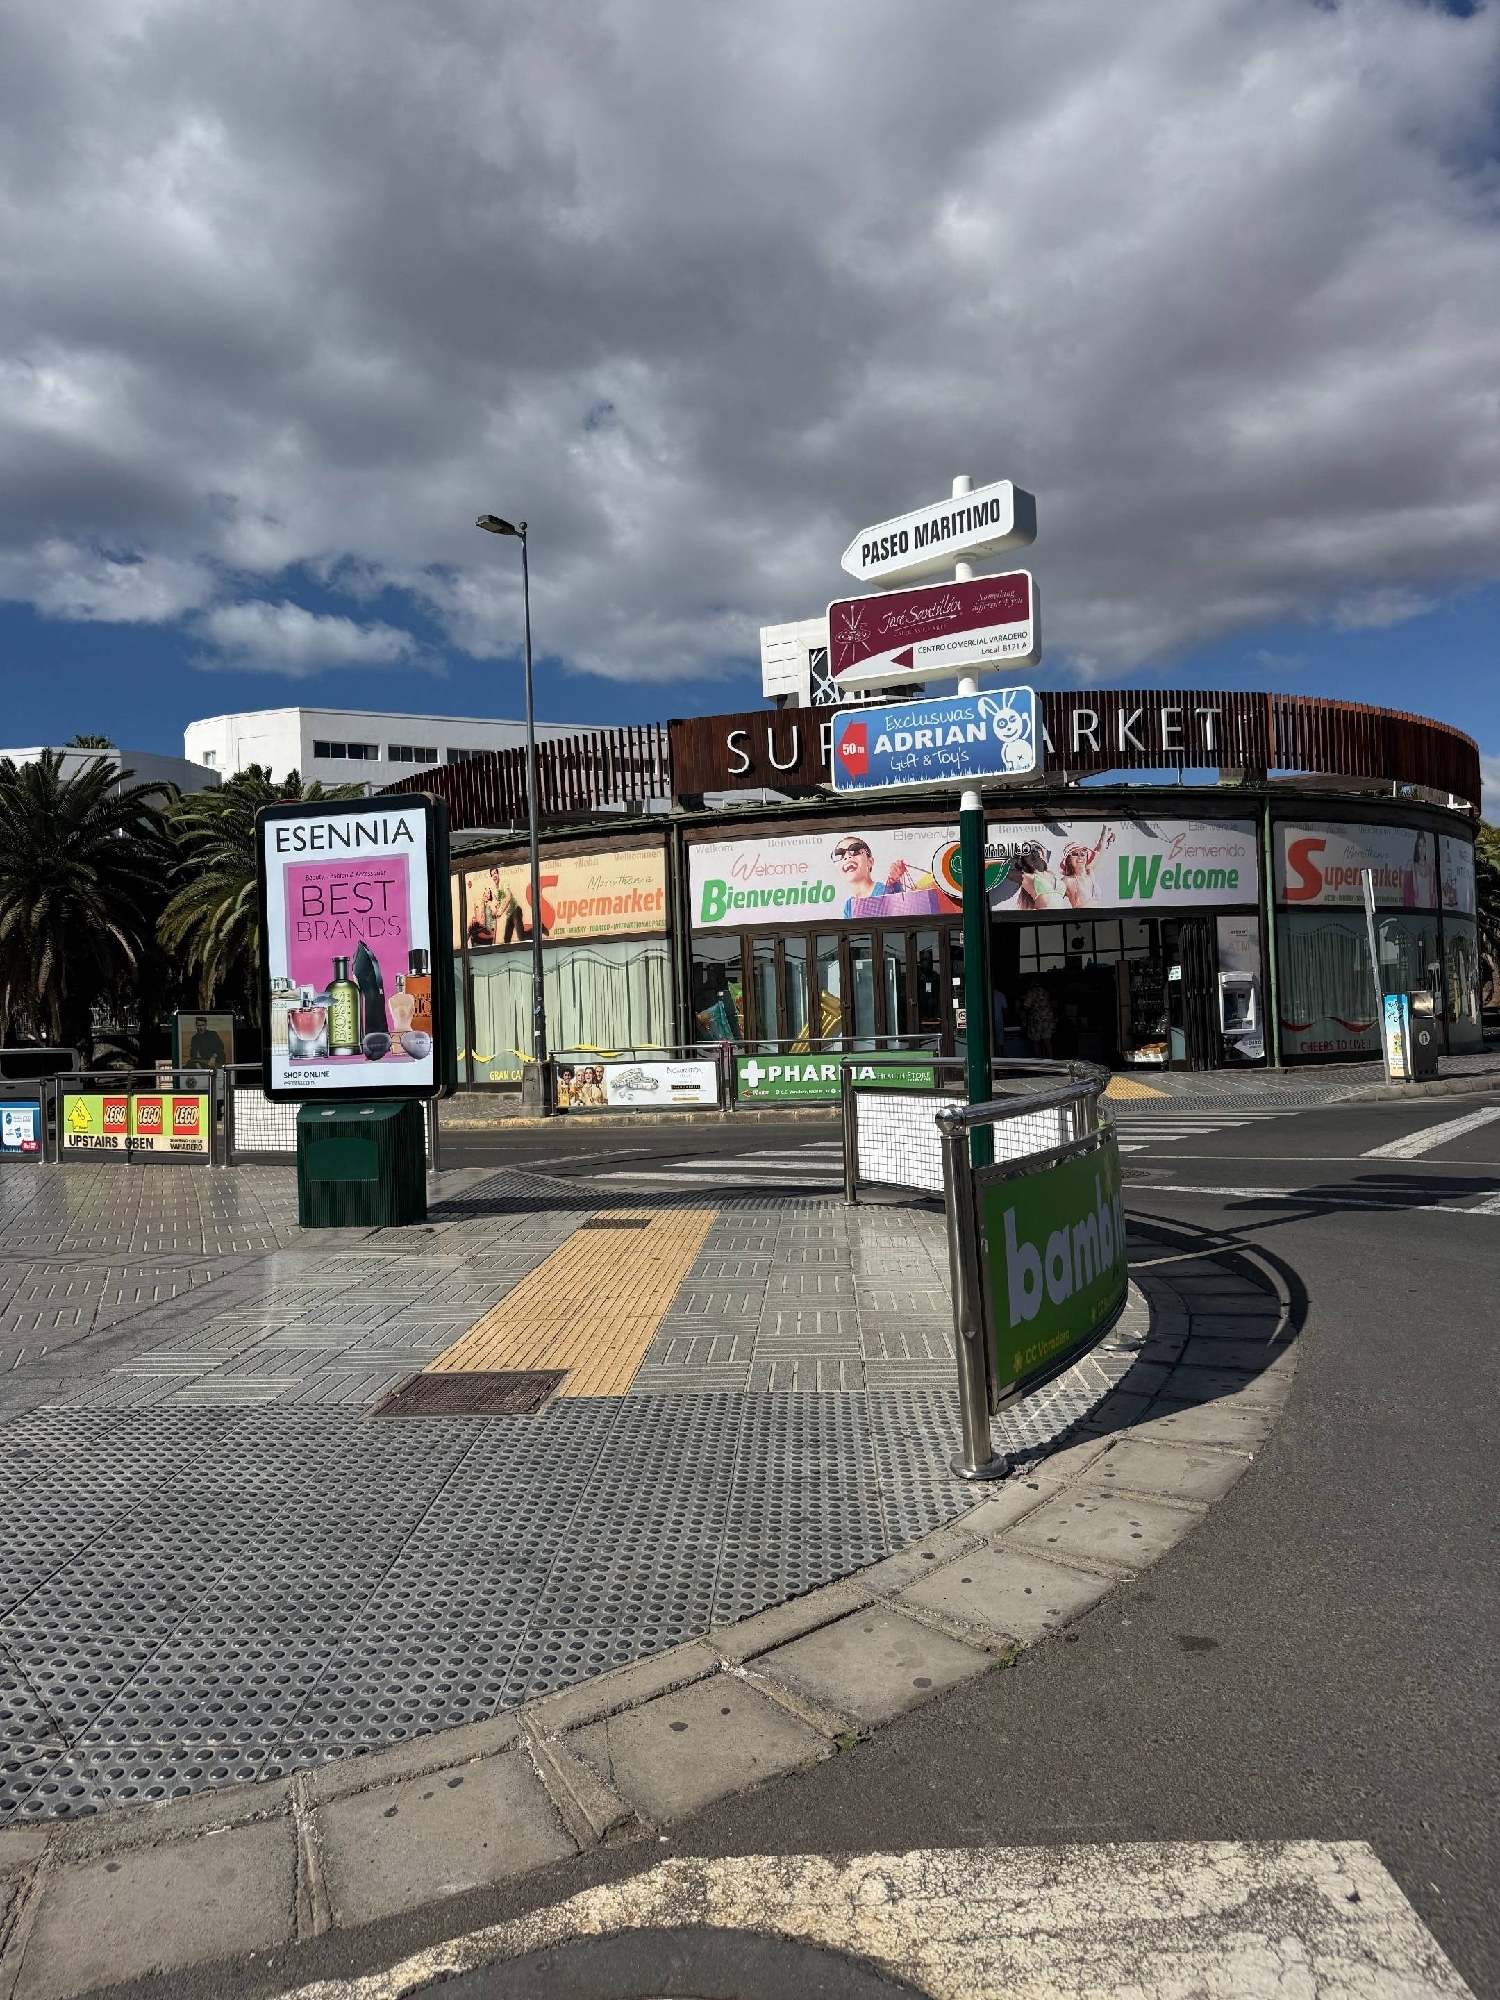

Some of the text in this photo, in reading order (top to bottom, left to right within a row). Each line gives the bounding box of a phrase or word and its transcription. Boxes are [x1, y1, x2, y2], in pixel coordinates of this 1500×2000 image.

[861, 498, 1000, 567] PASEO MARITIMO
[877, 609, 906, 634] José
[917, 631, 1028, 654] CENTRO COMERCIAL VARADERO
[981, 646, 1000, 655] Local
[884, 708, 975, 732] Exclusivas
[873, 721, 987, 755] ADRIAN
[890, 747, 970, 772] Gift & Toy's
[276, 817, 414, 853] ESENNIA
[893, 828, 956, 841] Bienvenue
[1188, 820, 1239, 832] Bienvenue
[695, 843, 734, 854] Welkom
[767, 836, 823, 848] Benvenuto
[1167, 832, 1246, 861] Bienvenido
[613, 850, 662, 862] Velkommen
[731, 853, 808, 881] Welcome
[1118, 854, 1239, 900] Welcome
[301, 880, 396, 917] BEST
[524, 875, 664, 932] Supermarket
[701, 878, 836, 923] Bienvenido
[296, 916, 401, 942] BRANDS
[1228, 940, 1250, 951] ATM
[1300, 1040, 1334, 1053] CHEERS
[283, 1070, 330, 1079] SHOP ONLINE
[489, 1071, 509, 1081] GRAN
[105, 1105, 127, 1125] LEGO
[138, 1105, 162, 1125] LEGO
[174, 1105, 200, 1127] LEGO
[68, 1135, 118, 1148] UPSTAIRS
[1025, 1328, 1070, 1365] CC Varadero
